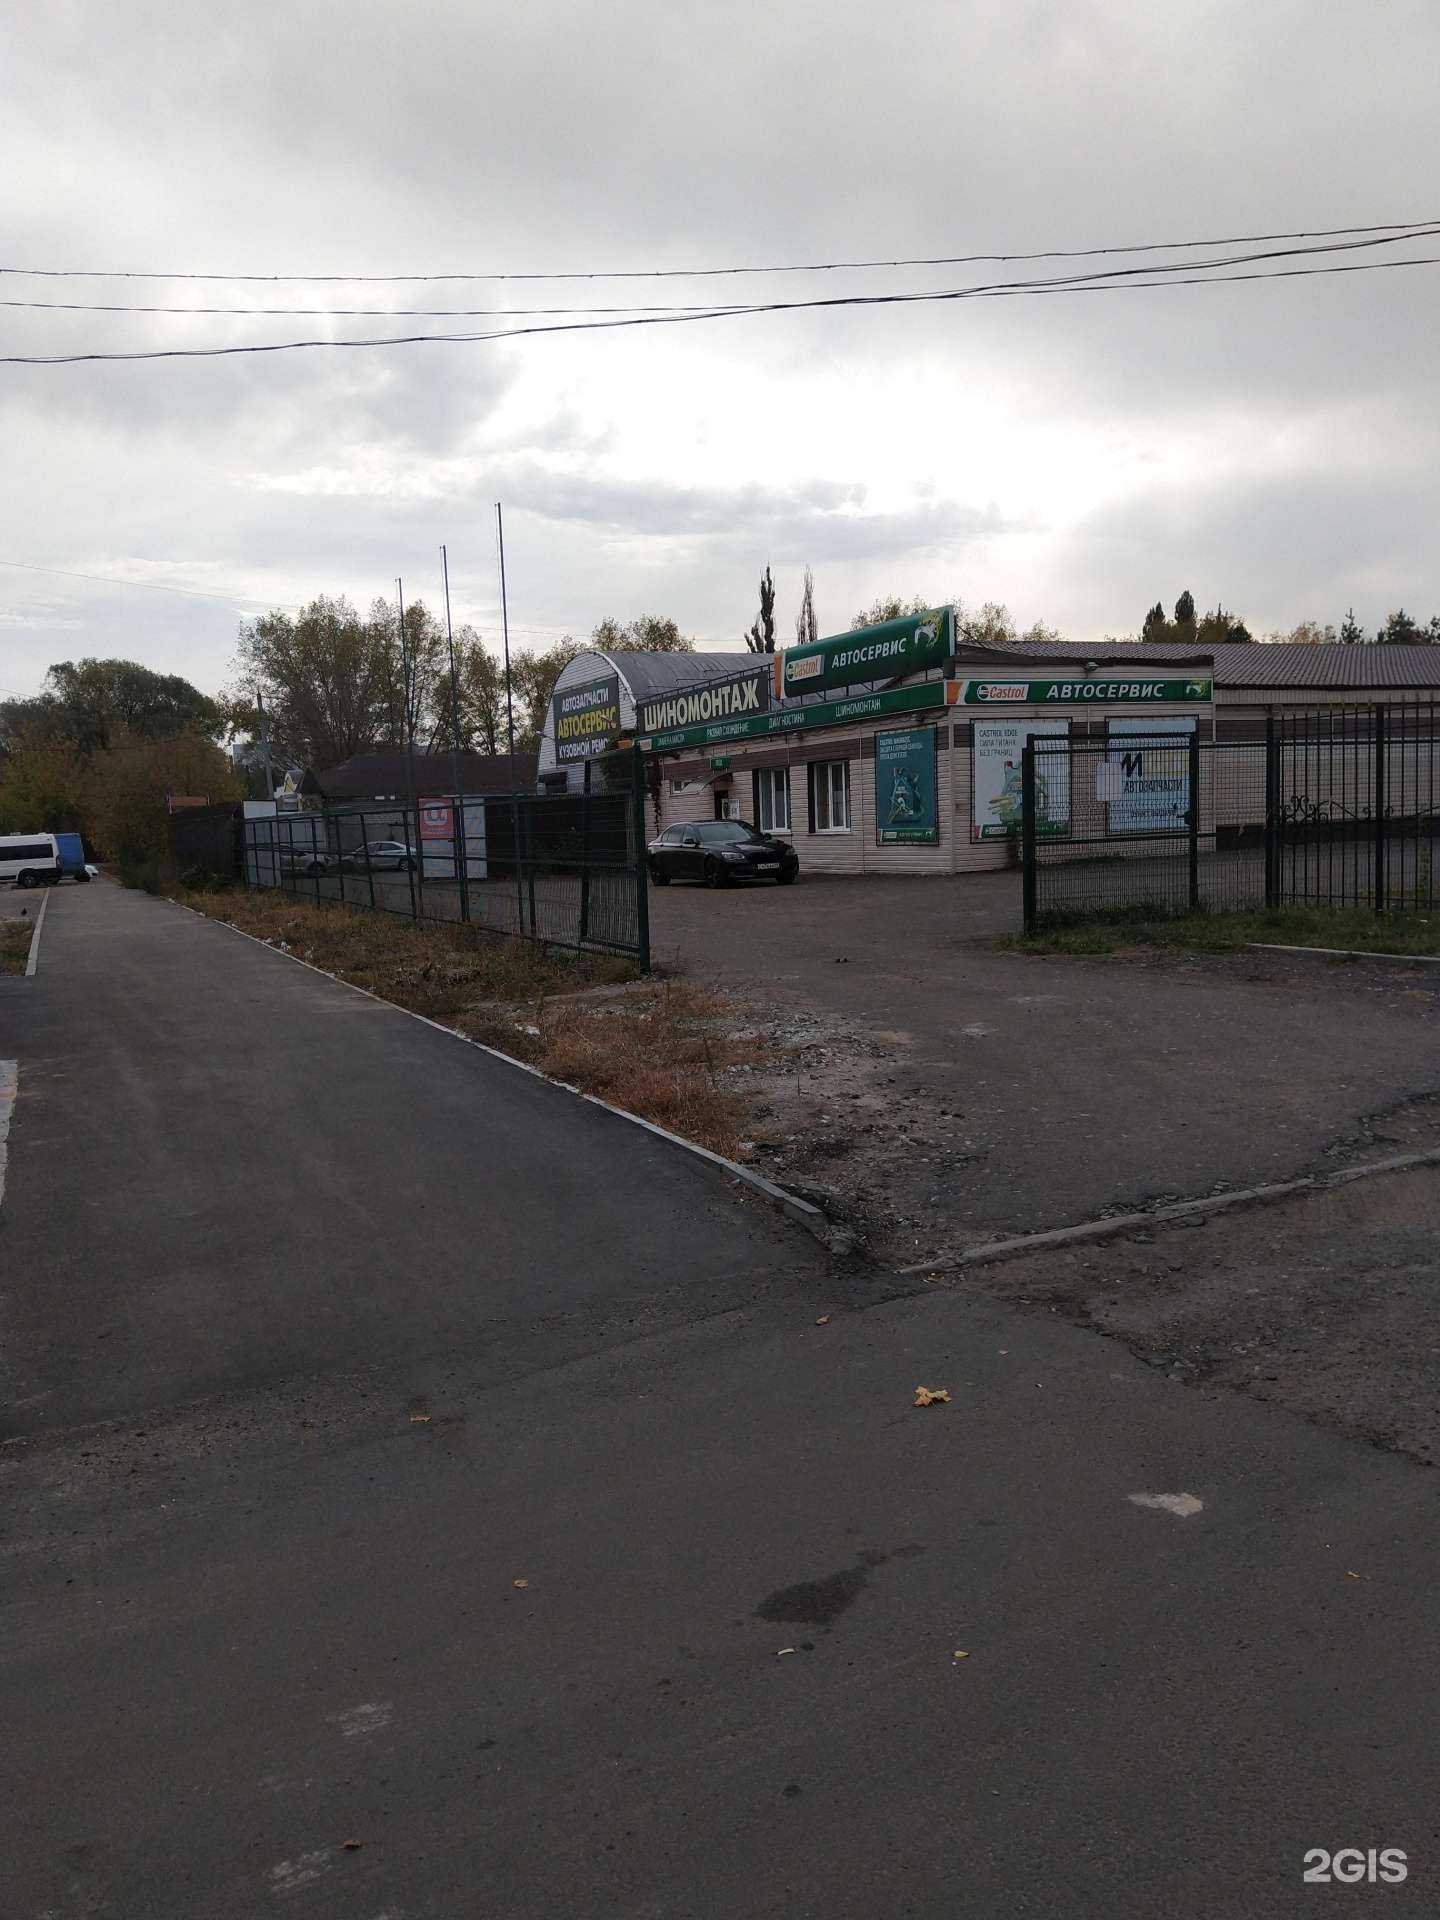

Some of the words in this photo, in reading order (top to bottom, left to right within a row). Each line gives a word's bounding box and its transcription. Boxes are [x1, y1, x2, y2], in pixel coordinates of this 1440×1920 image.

[832, 637, 907, 669] АВТОСЕРВИС
[794, 655, 819, 678] Castrol
[562, 688, 609, 712] АВТОЗАПЧАСТИ
[989, 685, 1025, 699] Castrol
[1046, 683, 1164, 699] АВТОСЕРВИС
[644, 678, 759, 732] ШИНОМОНТАЖ
[835, 698, 881, 718] ШИНОМОНТАЖ
[558, 706, 616, 738] АВТОСЕРВИС
[768, 712, 805, 730] ДИАГНОСТИКА
[559, 737, 590, 759] КУЗОВНОЙ
[1123, 780, 1182, 793] АВТОЗАПЧАСТИ
